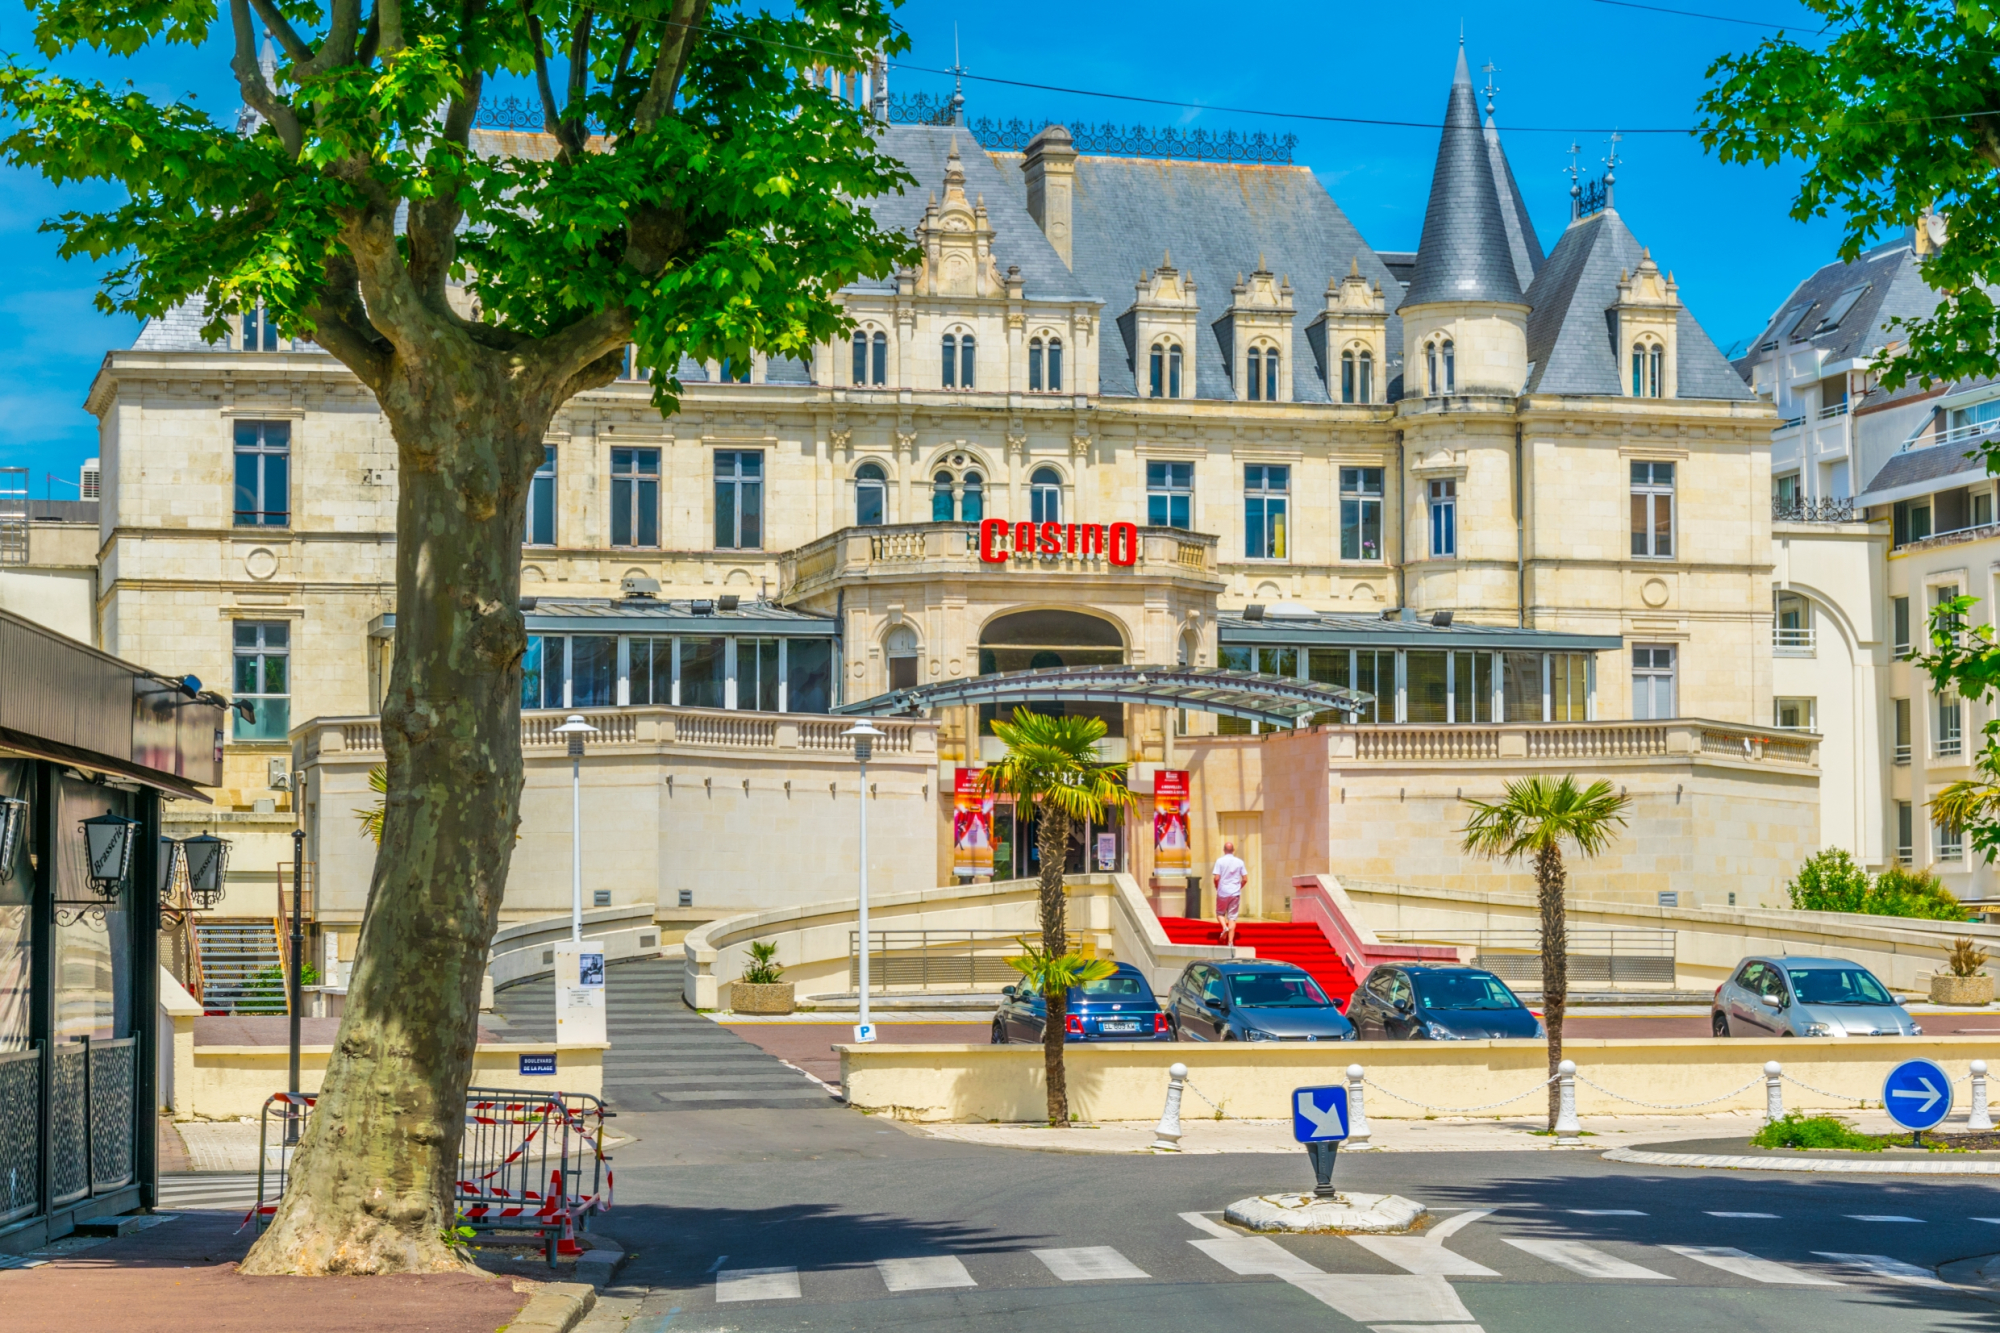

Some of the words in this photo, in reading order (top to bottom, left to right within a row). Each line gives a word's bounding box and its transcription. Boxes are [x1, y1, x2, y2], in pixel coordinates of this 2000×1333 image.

[94, 825, 123, 874] Brasserie
[192, 844, 218, 886] Brasserie
[860, 1026, 870, 1038] P
